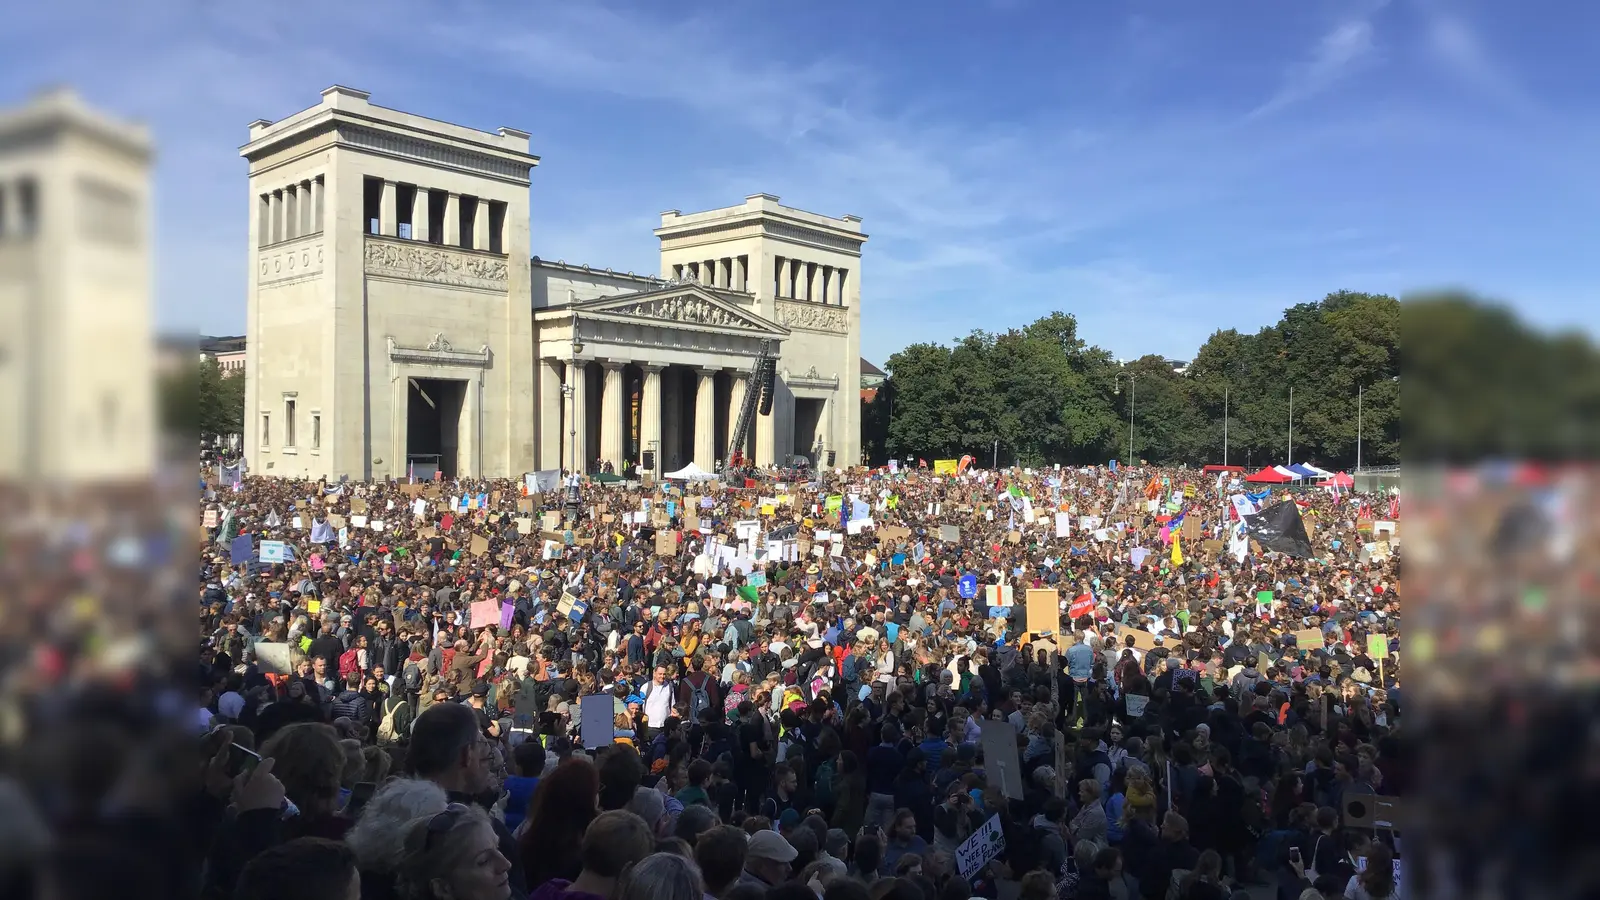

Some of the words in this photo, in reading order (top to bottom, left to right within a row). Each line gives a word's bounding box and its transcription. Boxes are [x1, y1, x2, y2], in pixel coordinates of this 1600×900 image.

[958, 833, 978, 856] WE
[981, 821, 992, 839] !!!
[965, 843, 987, 866] NEED
[961, 861, 980, 879] THIS
[982, 836, 1005, 862] PLANET
